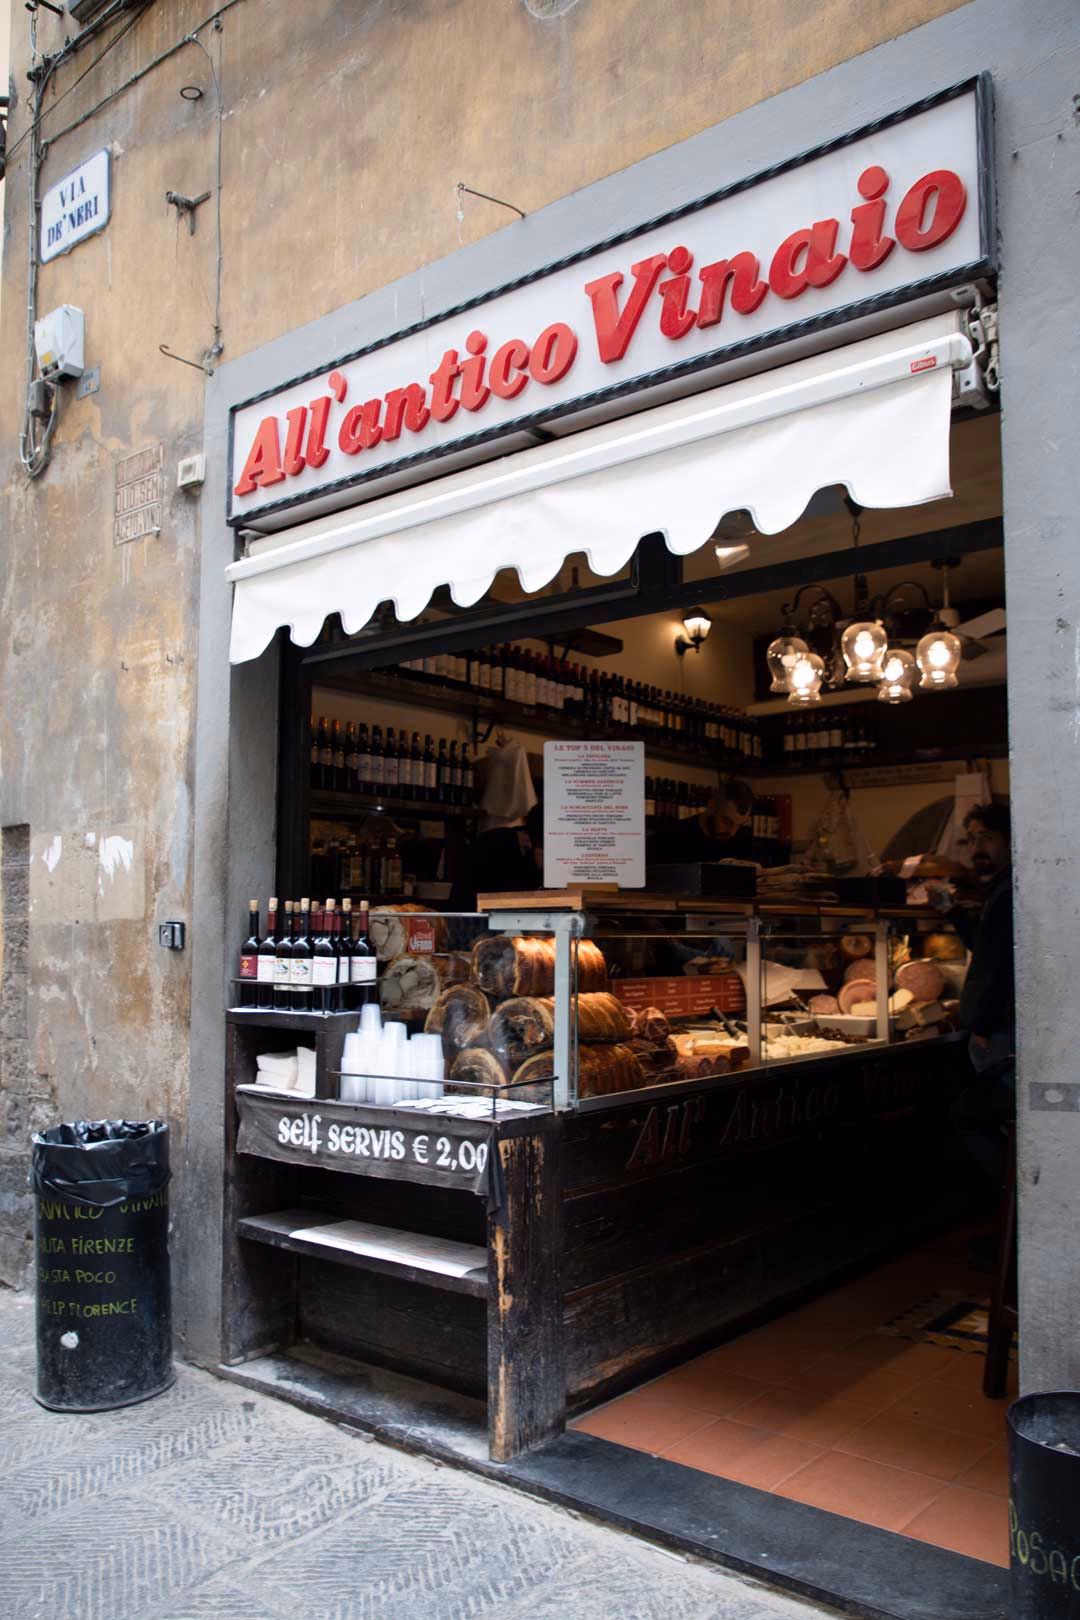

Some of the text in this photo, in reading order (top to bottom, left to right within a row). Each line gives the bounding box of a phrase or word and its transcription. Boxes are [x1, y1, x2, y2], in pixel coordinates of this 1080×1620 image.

[60, 176, 85, 208] VIA
[233, 165, 968, 498] All'antico Vinaio
[71, 1236, 135, 1255] FIRENZE
[75, 1268, 117, 1284] POCO
[69, 1298, 138, 1319] FLORENCE
